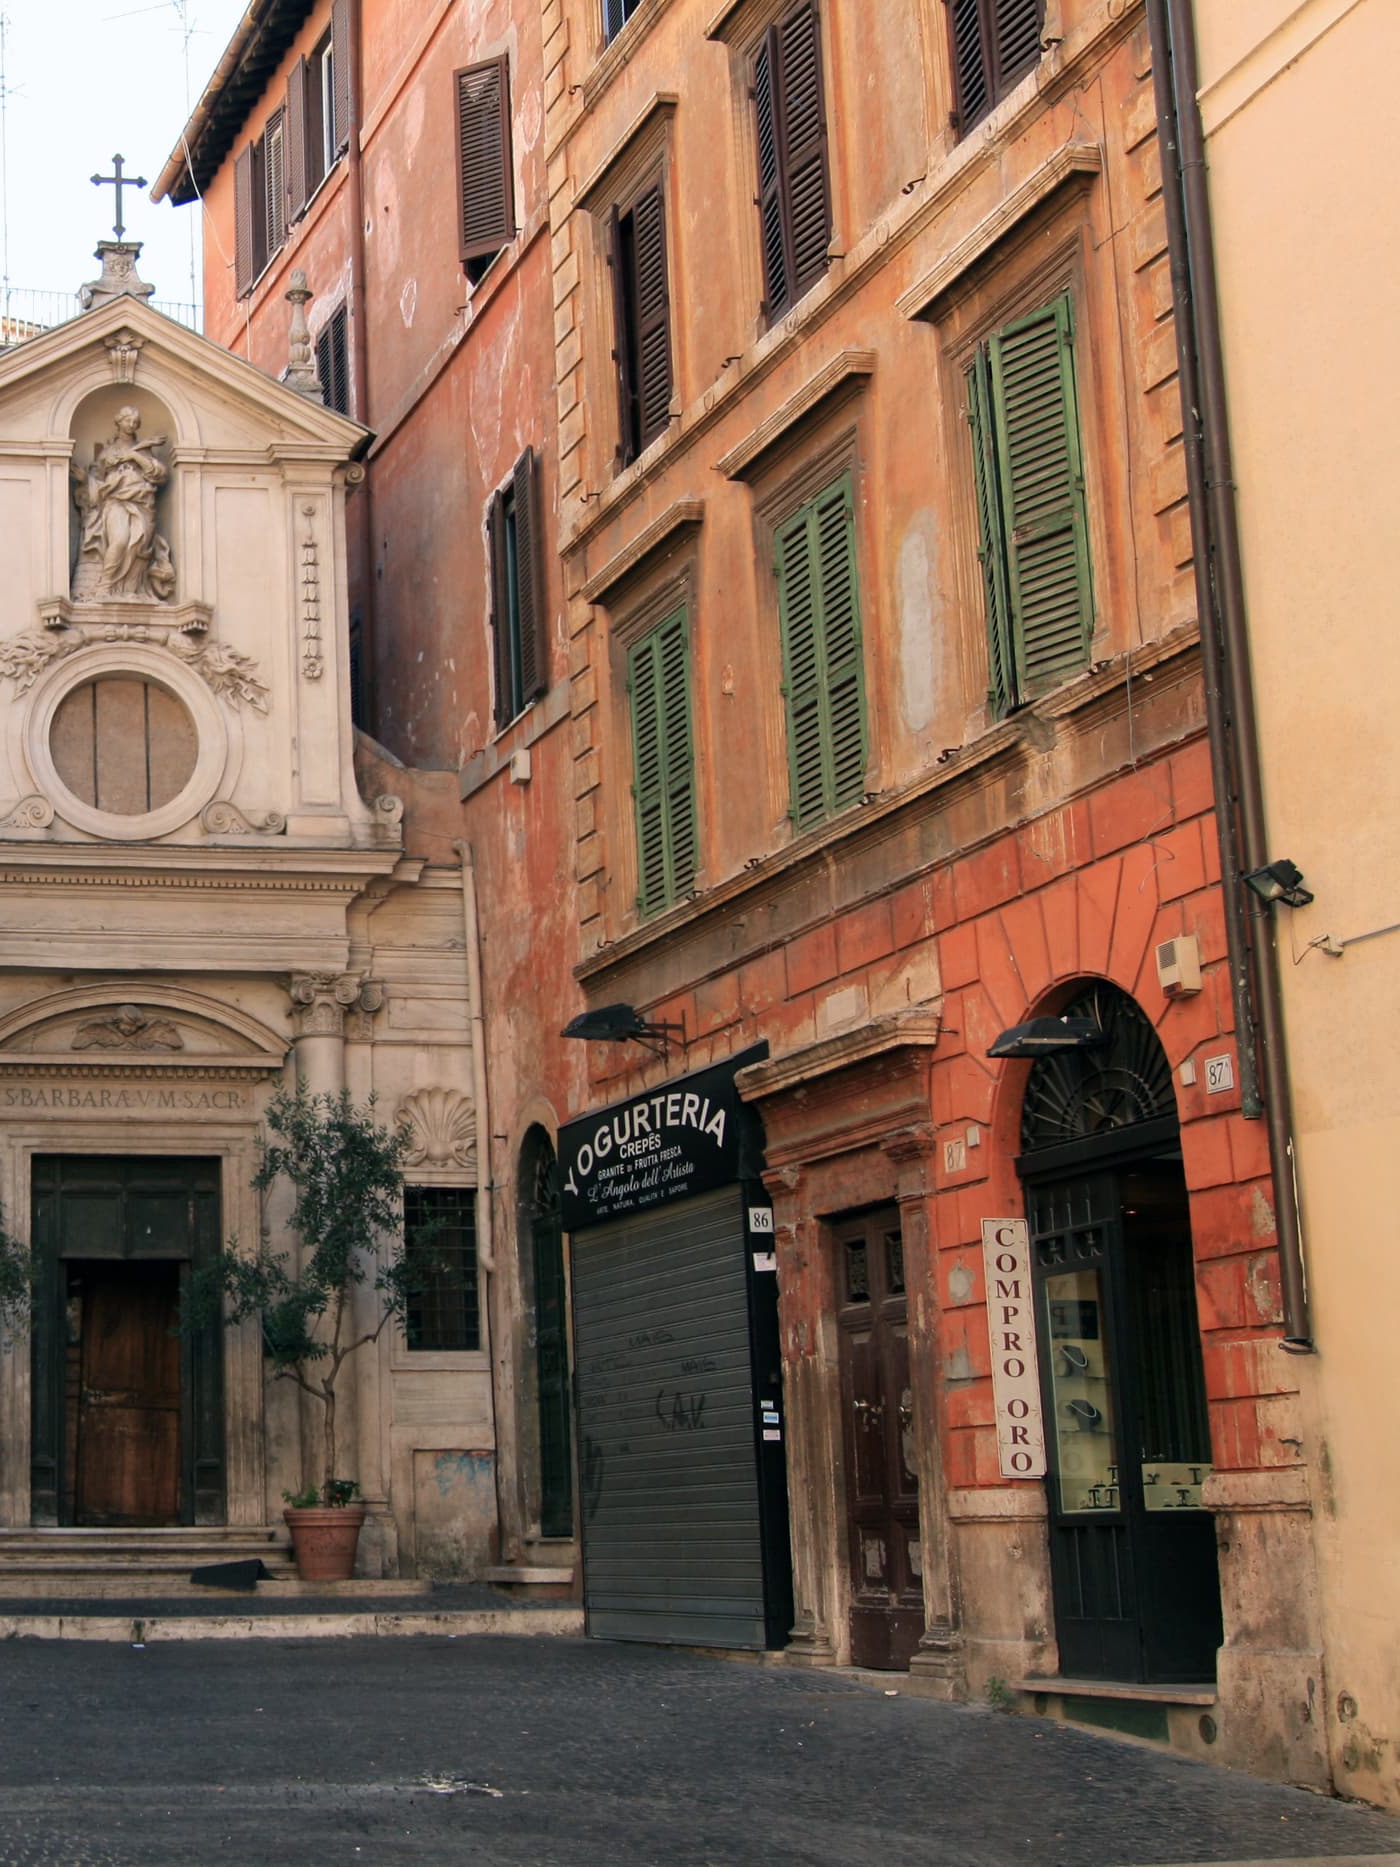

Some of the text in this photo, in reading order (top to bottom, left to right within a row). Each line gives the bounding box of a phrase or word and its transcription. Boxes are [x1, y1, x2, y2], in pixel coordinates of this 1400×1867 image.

[564, 1092, 726, 1197] YOGURTERIA
[946, 1141, 962, 1169] 87
[597, 1163, 625, 1181] GRANITE
[634, 1154, 659, 1170] FRUTTA
[660, 1145, 682, 1162] FRESCA
[753, 1212, 769, 1228] 86
[994, 1227, 1032, 1472] COMPRO ORO
